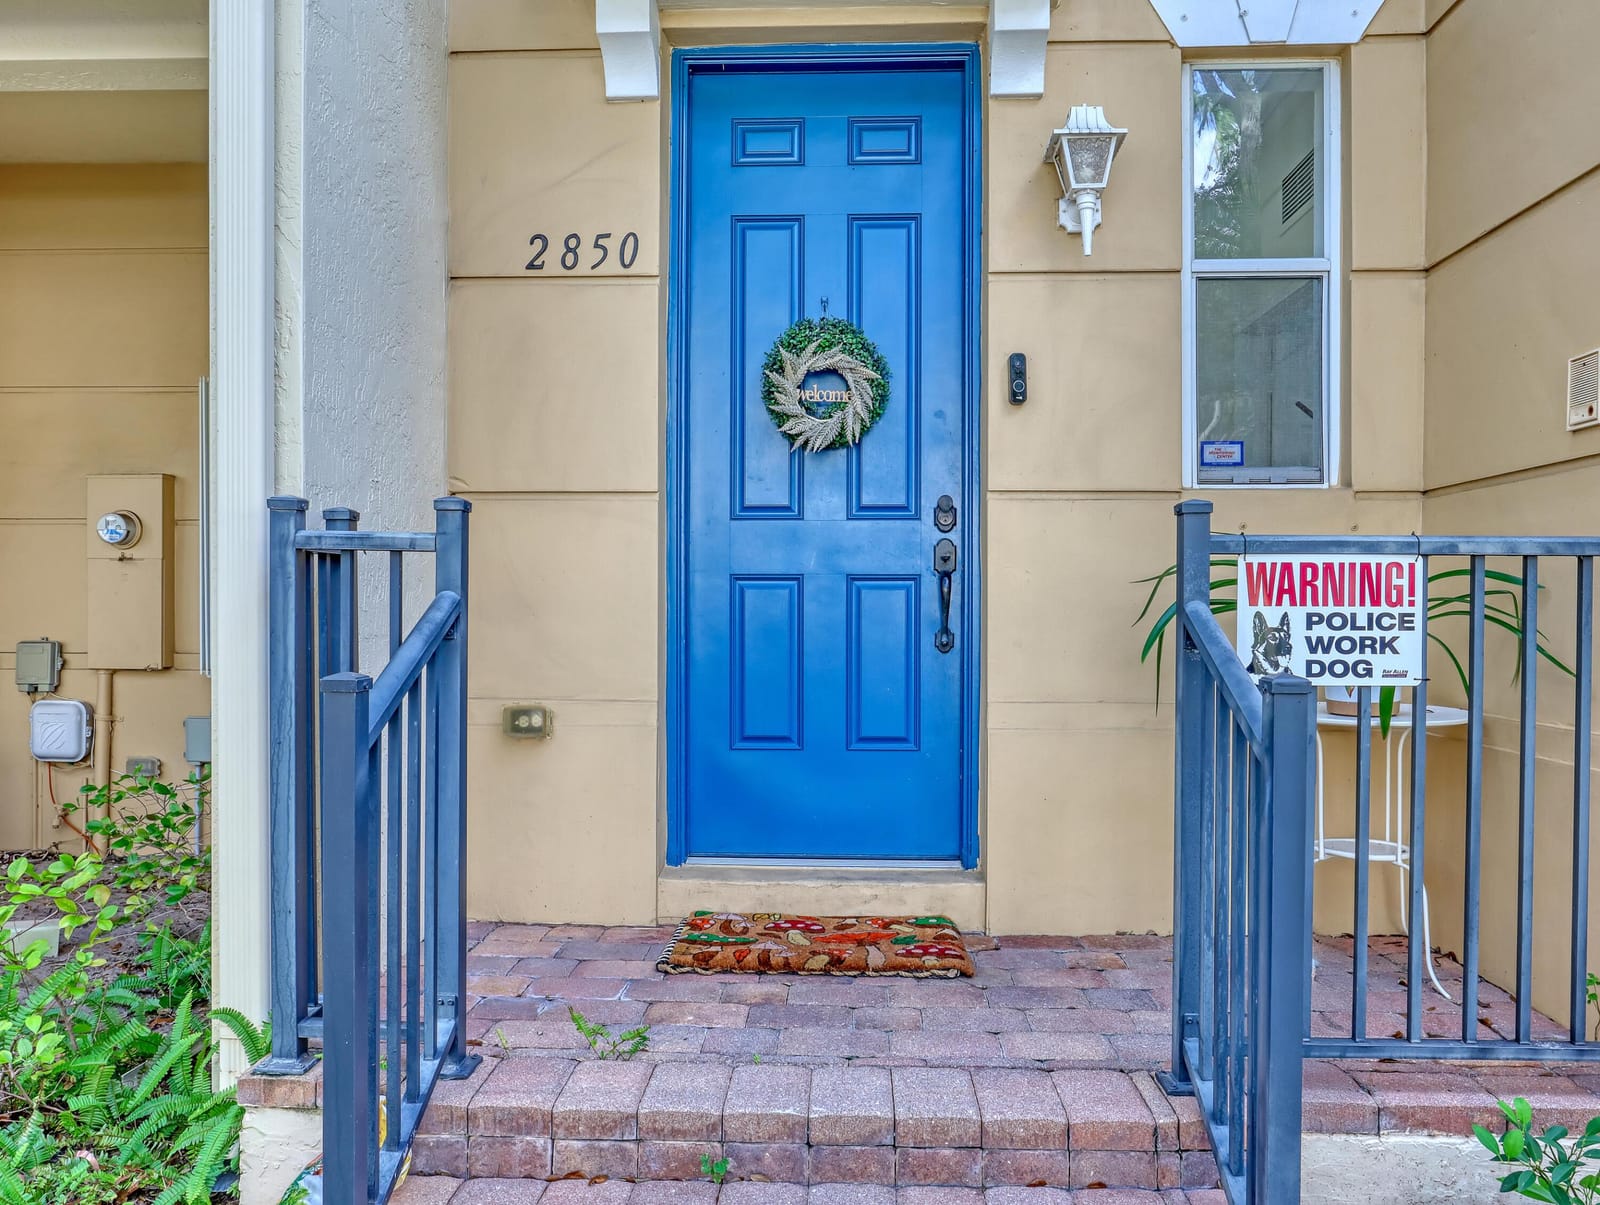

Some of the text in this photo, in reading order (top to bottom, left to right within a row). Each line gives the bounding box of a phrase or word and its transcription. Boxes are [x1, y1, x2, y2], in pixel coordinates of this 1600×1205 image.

[525, 232, 639, 270] 2850
[797, 384, 852, 402] welcome
[1245, 561, 1416, 608] WARNING!
[1305, 612, 1416, 631] POLICE
[1304, 636, 1400, 654] WORK
[1305, 659, 1374, 678] DOG
